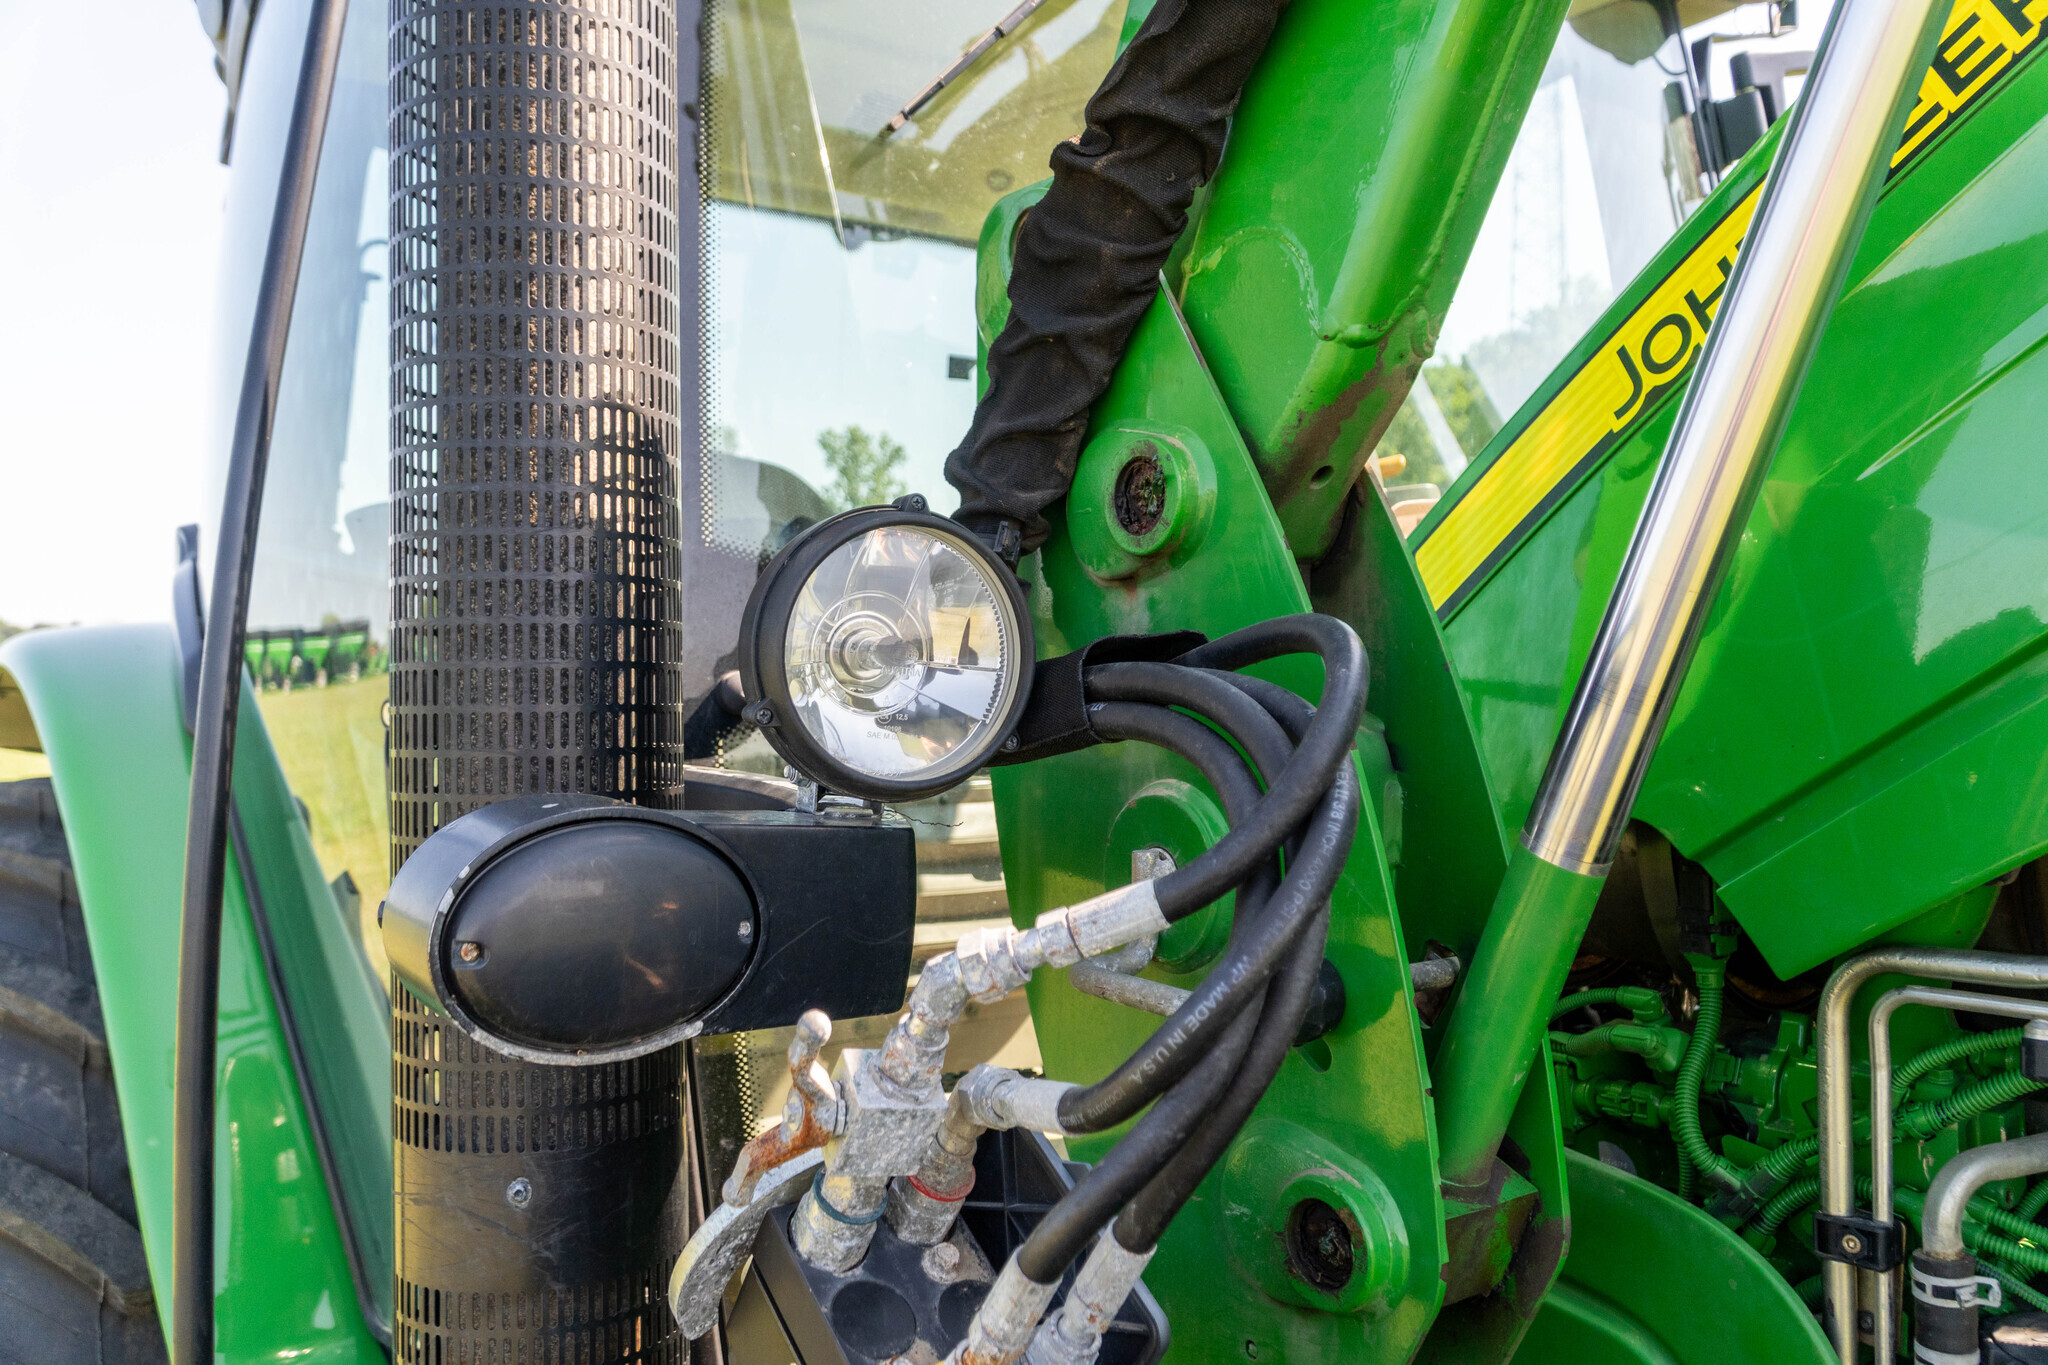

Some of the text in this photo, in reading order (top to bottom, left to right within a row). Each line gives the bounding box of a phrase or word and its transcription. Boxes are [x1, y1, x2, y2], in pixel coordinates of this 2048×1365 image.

[1613, 237, 1746, 421] JOH
[1330, 800, 1347, 820] 3/8
[1322, 820, 1342, 857] INCH
[1280, 891, 1304, 919] PSI
[1184, 981, 1231, 1033] MADE
[1167, 1027, 1188, 1050] IN
